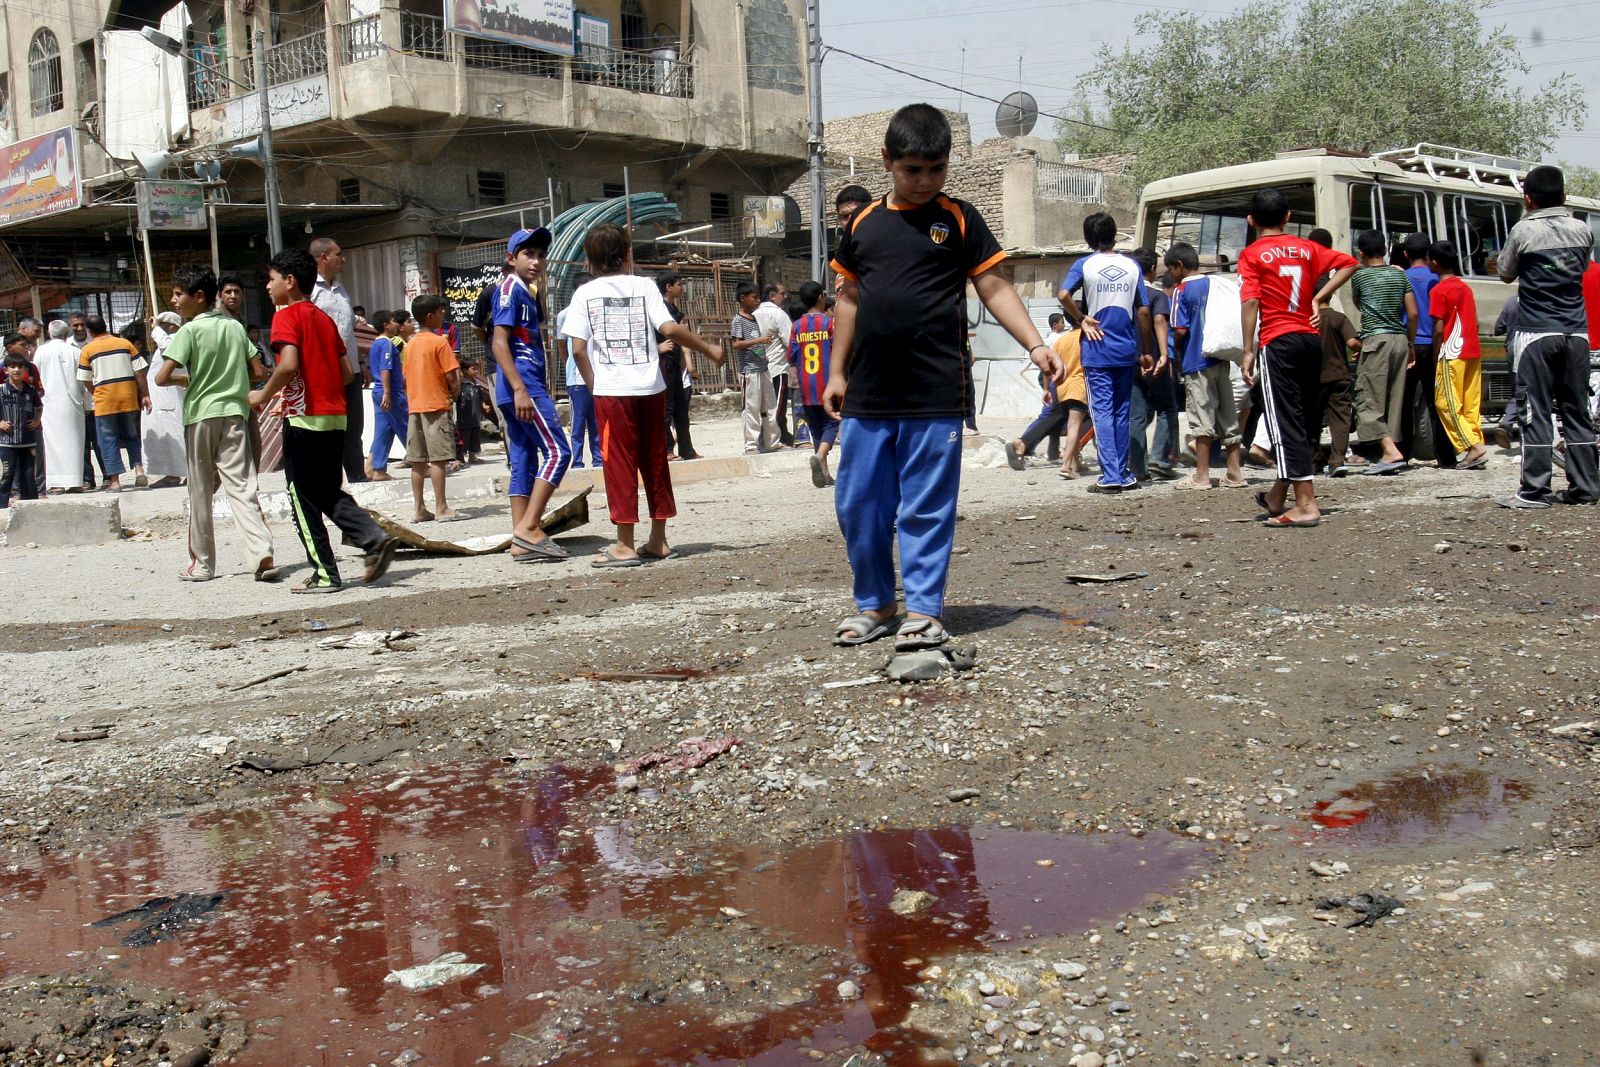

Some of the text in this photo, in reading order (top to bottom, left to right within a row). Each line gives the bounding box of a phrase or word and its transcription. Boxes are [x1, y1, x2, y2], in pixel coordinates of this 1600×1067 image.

[1261, 246, 1310, 264] OWEN
[1097, 283, 1130, 293] UMBRO
[1279, 265, 1302, 312] 7
[804, 343, 820, 374] 8
